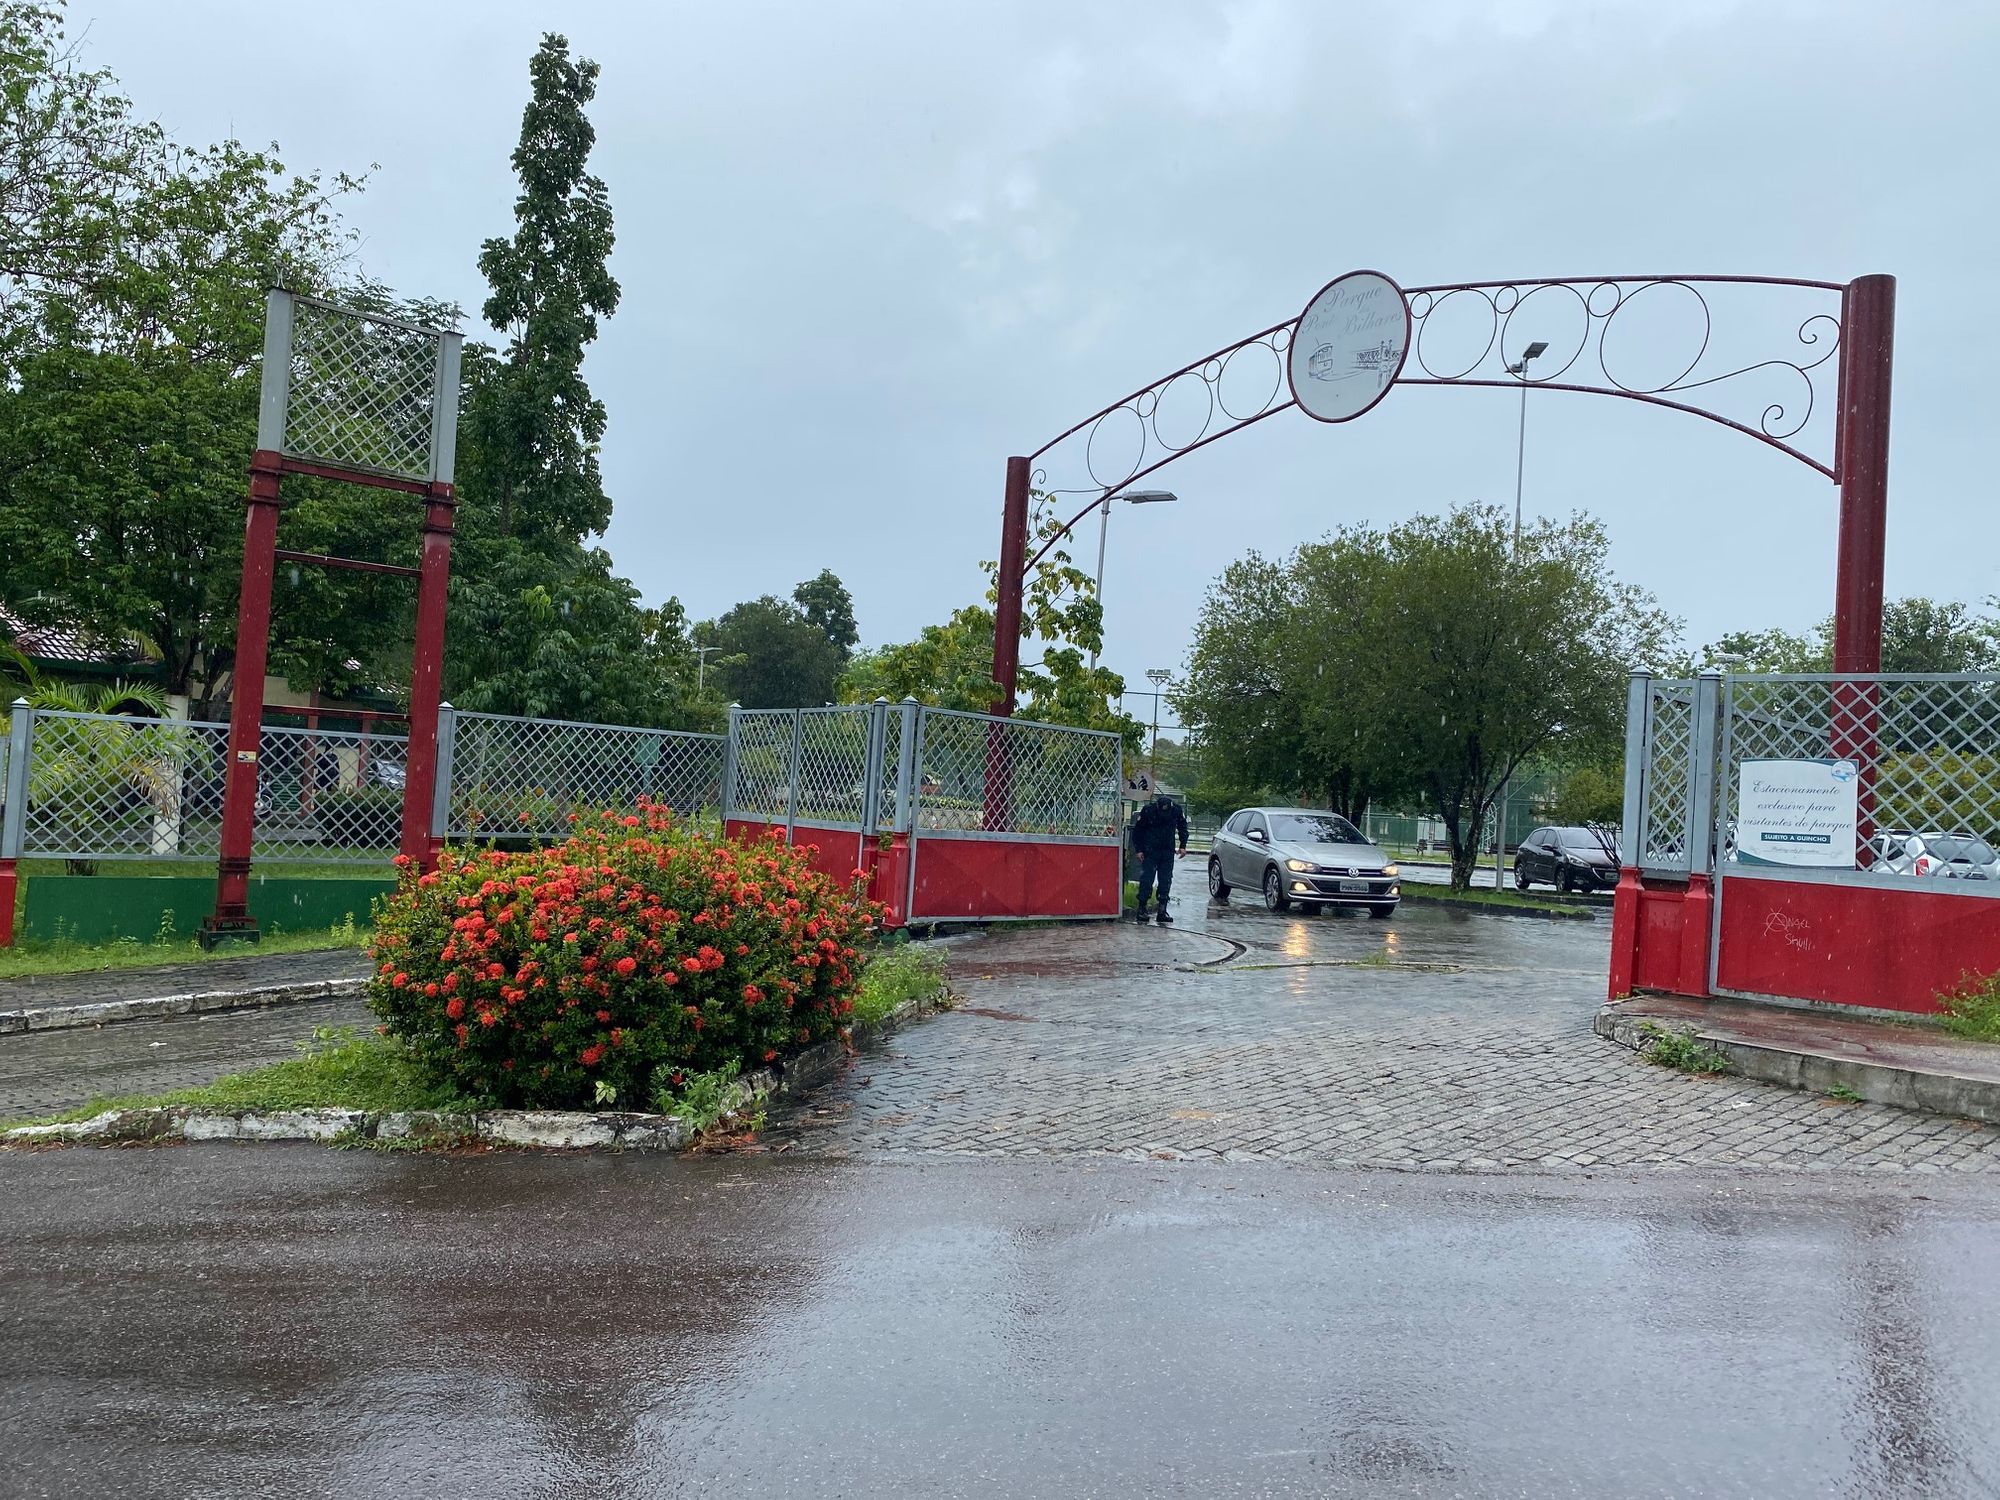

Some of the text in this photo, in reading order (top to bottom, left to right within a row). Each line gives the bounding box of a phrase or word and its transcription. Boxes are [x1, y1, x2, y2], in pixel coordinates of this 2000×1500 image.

[1752, 780, 1840, 795] Estacionamento
[1757, 799, 1837, 815] exclusivo para
[1743, 816, 1852, 833] visitantes do parque
